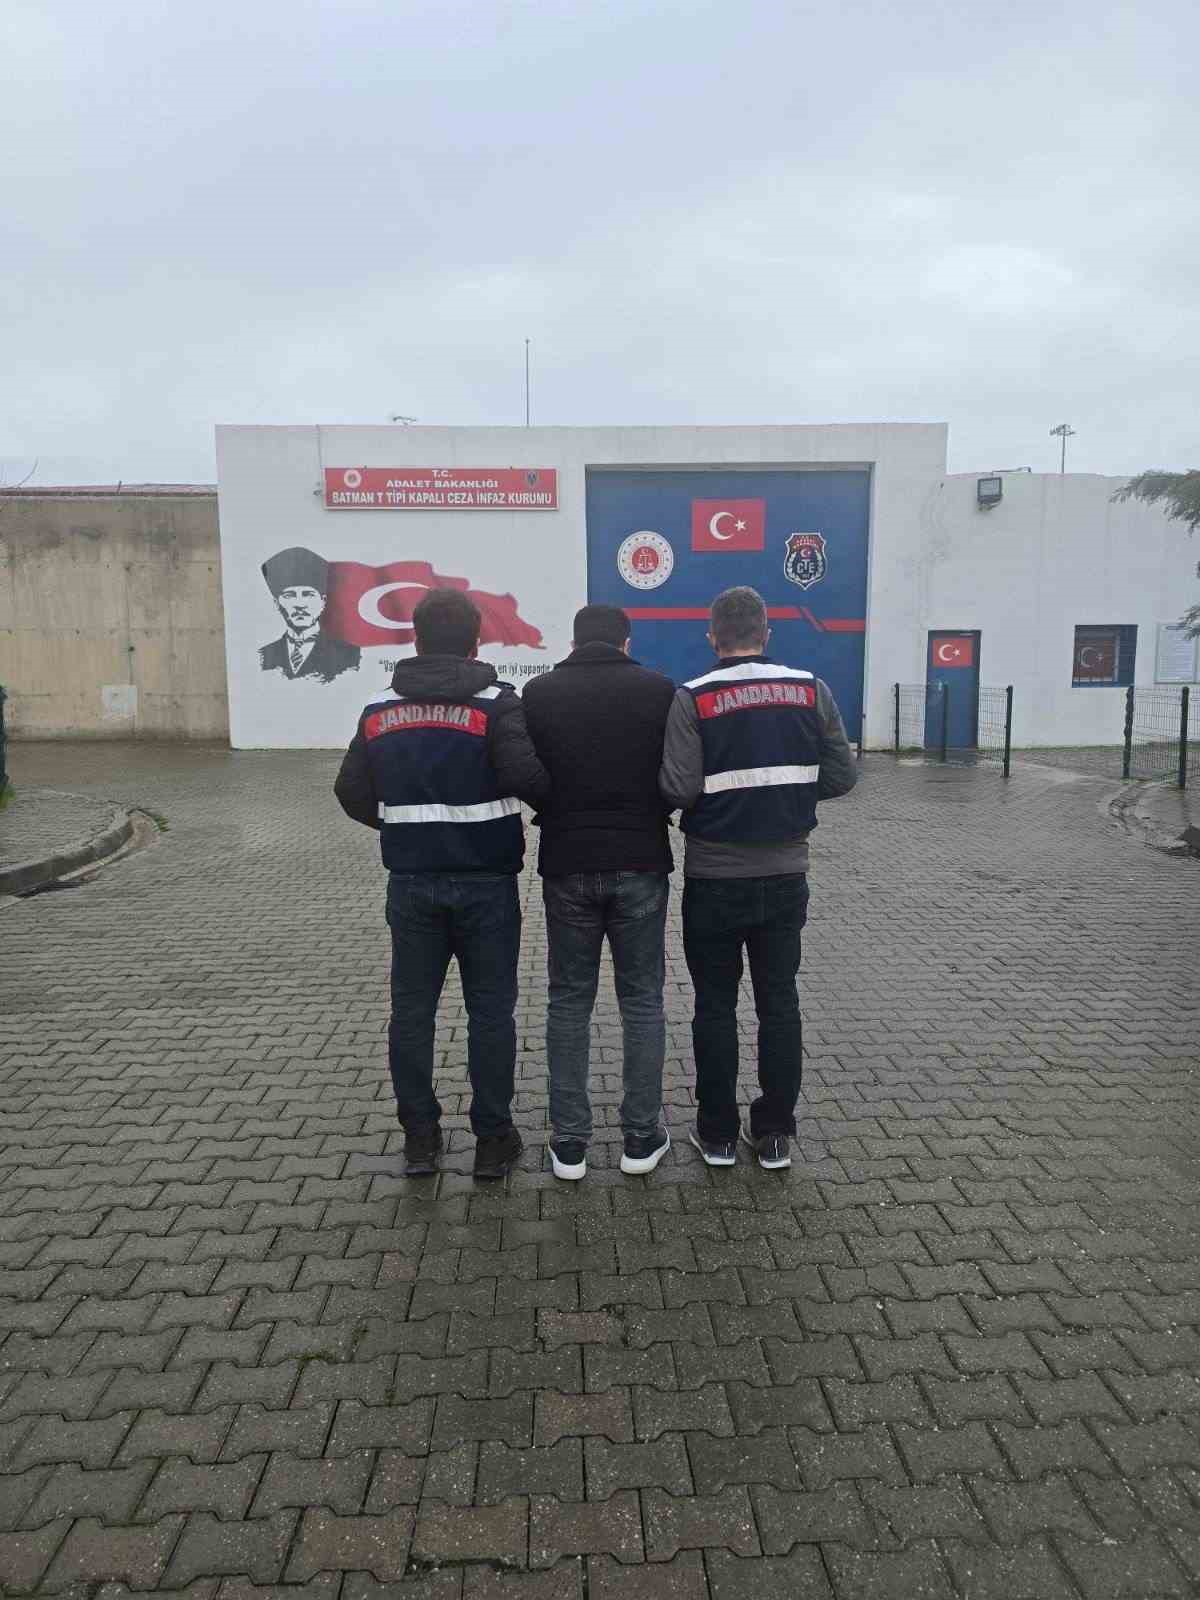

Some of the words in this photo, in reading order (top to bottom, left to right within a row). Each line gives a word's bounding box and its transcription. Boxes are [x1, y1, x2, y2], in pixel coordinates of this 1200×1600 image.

[432, 469, 453, 478] T.C.
[386, 479, 432, 488] ADALET
[434, 478, 499, 488] BAKANLIĞI
[332, 491, 375, 504] BATMAN
[376, 491, 384, 504] T
[385, 489, 407, 504] TİPİ
[408, 491, 445, 504] KAPALI
[447, 492, 474, 504] CEZA
[476, 490, 506, 505] İNFAZ
[508, 492, 552, 505] KURUMU
[713, 685, 808, 714] JANDARMA
